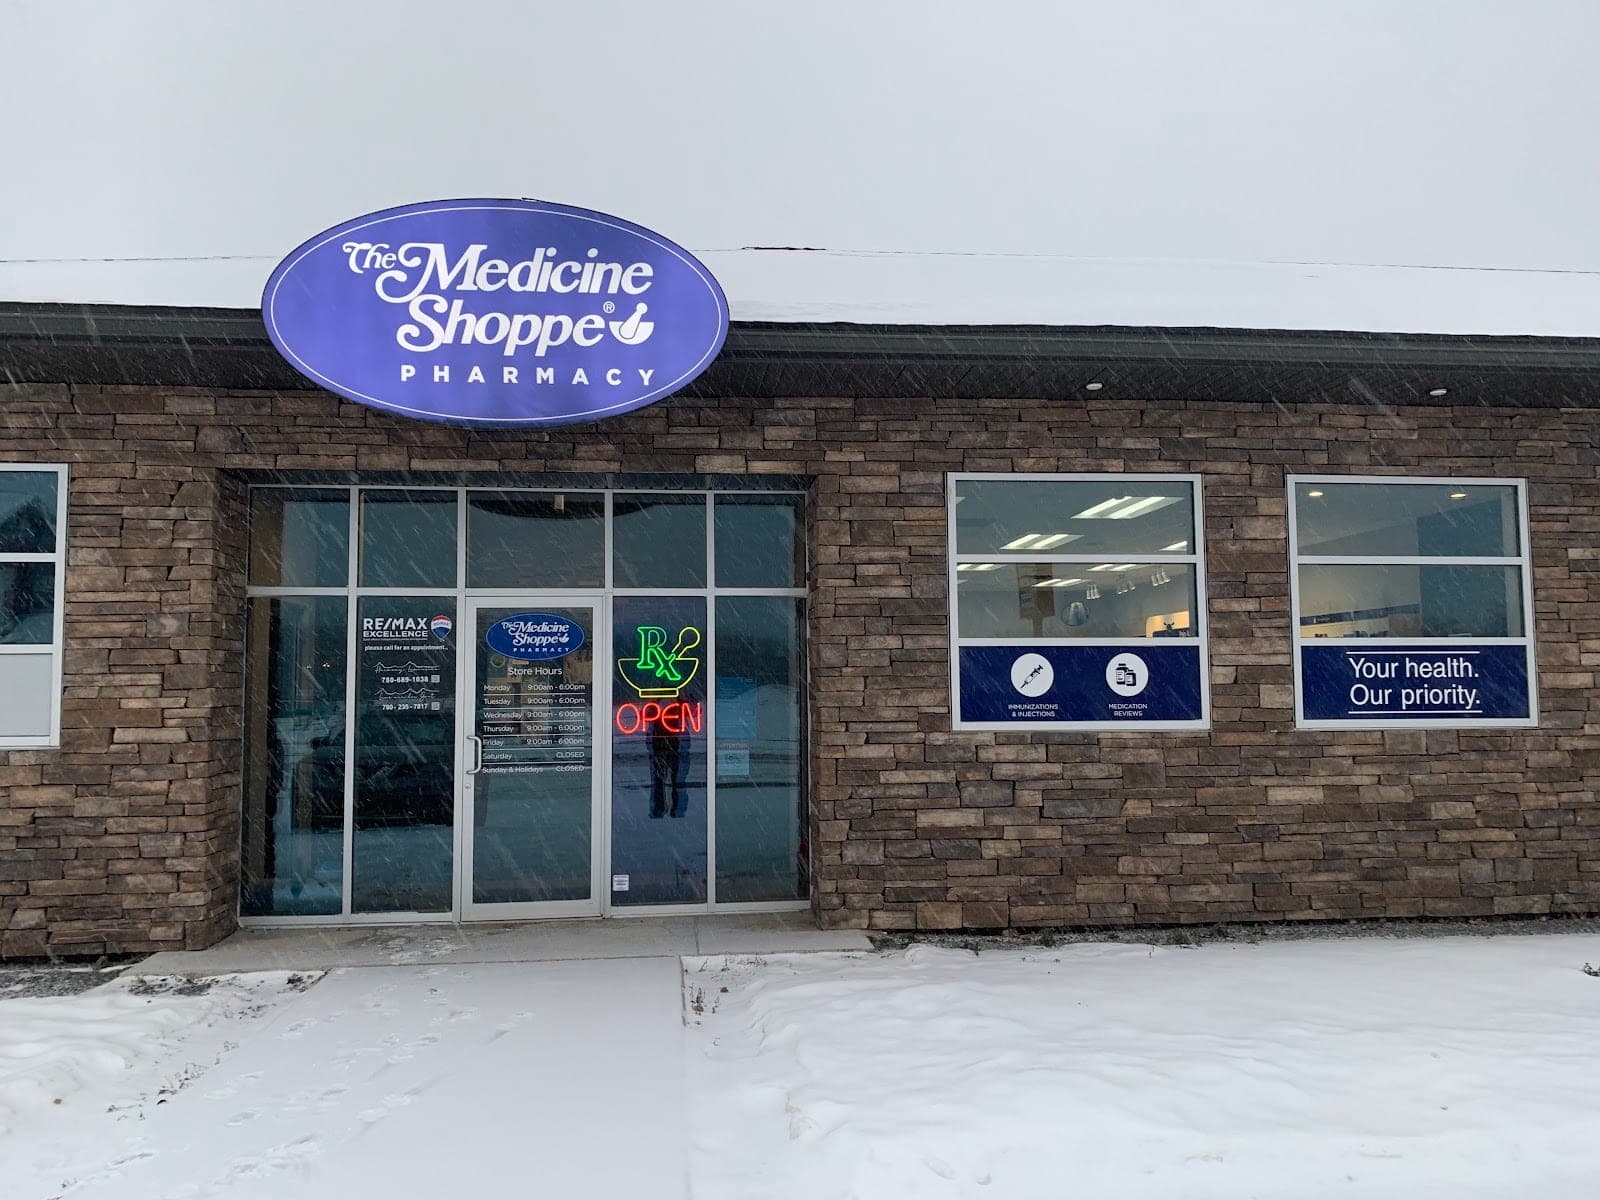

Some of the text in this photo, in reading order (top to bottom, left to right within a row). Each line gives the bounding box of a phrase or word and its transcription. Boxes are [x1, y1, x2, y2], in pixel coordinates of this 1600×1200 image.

[342, 242, 654, 303] The Medicine
[400, 365, 655, 386] PHARMACY
[363, 618, 428, 630] RE/MAX
[508, 621, 570, 635] Medicine
[507, 666, 563, 676] Store Hours
[1348, 657, 1480, 678] Your health.
[484, 698, 512, 706] Tuesday
[1350, 684, 1481, 710] Our priority.
[483, 712, 523, 720] Wednesday
[616, 702, 701, 734] OPEN
[1018, 710, 1056, 718] INJECTIONS
[483, 739, 504, 747] Friday
